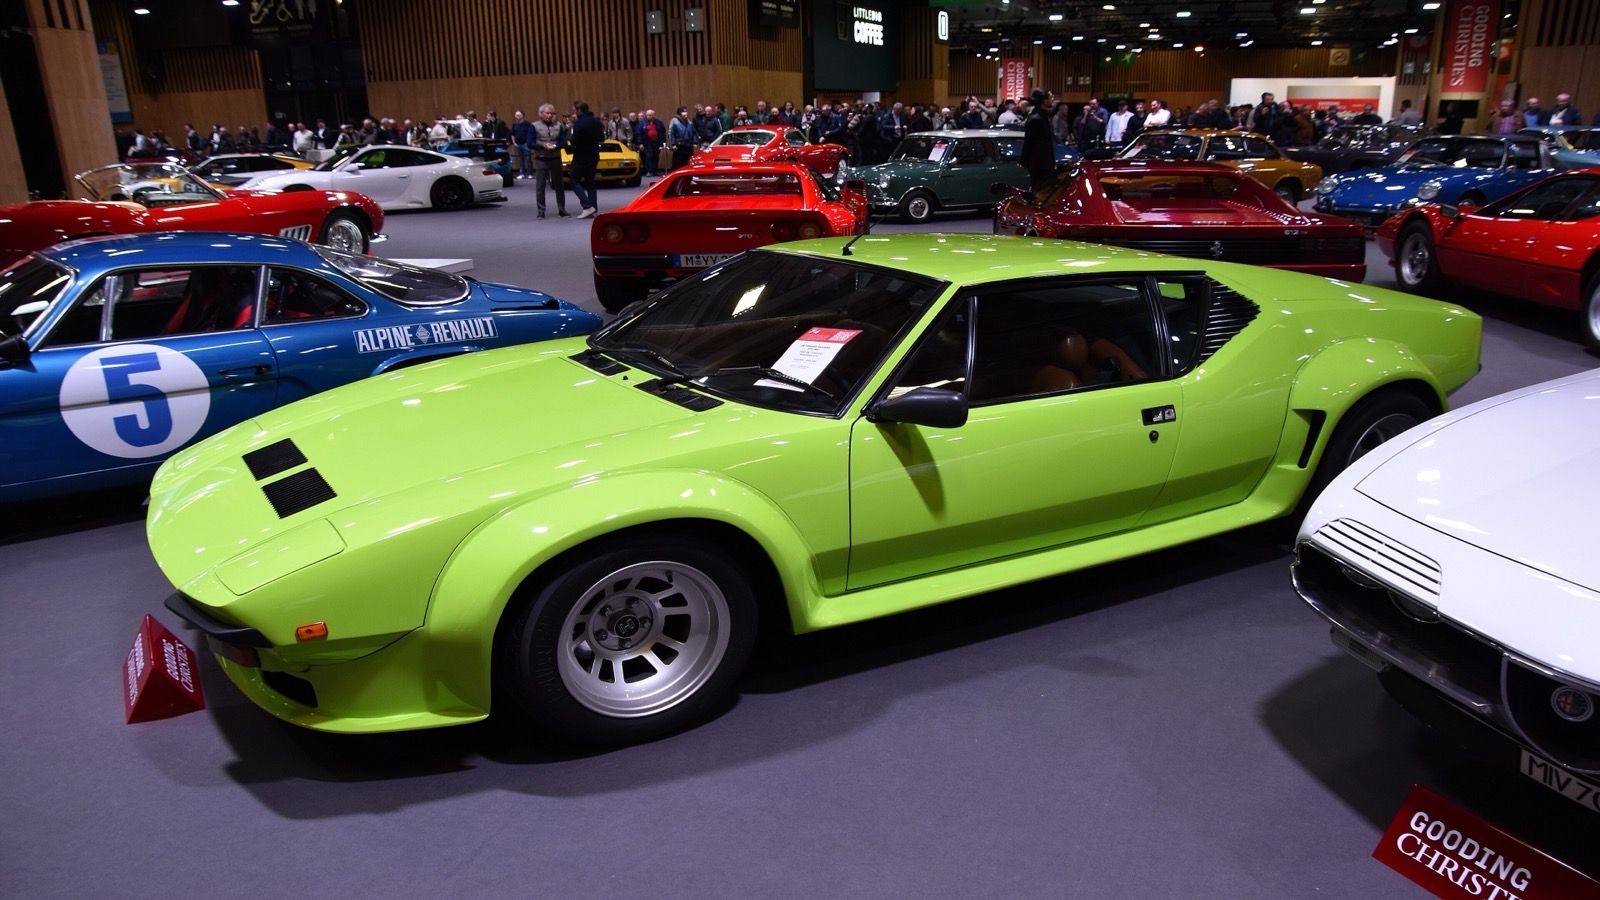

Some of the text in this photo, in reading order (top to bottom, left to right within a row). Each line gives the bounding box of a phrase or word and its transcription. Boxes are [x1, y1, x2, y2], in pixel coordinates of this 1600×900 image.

[853, 7, 882, 22] LITTLEBIG
[854, 21, 883, 46] COFFEE
[1468, 5, 1490, 67] GOODING
[357, 317, 494, 351] ALPINE RENAULT
[99, 352, 173, 447] 5
[1410, 811, 1532, 892] GOODING
